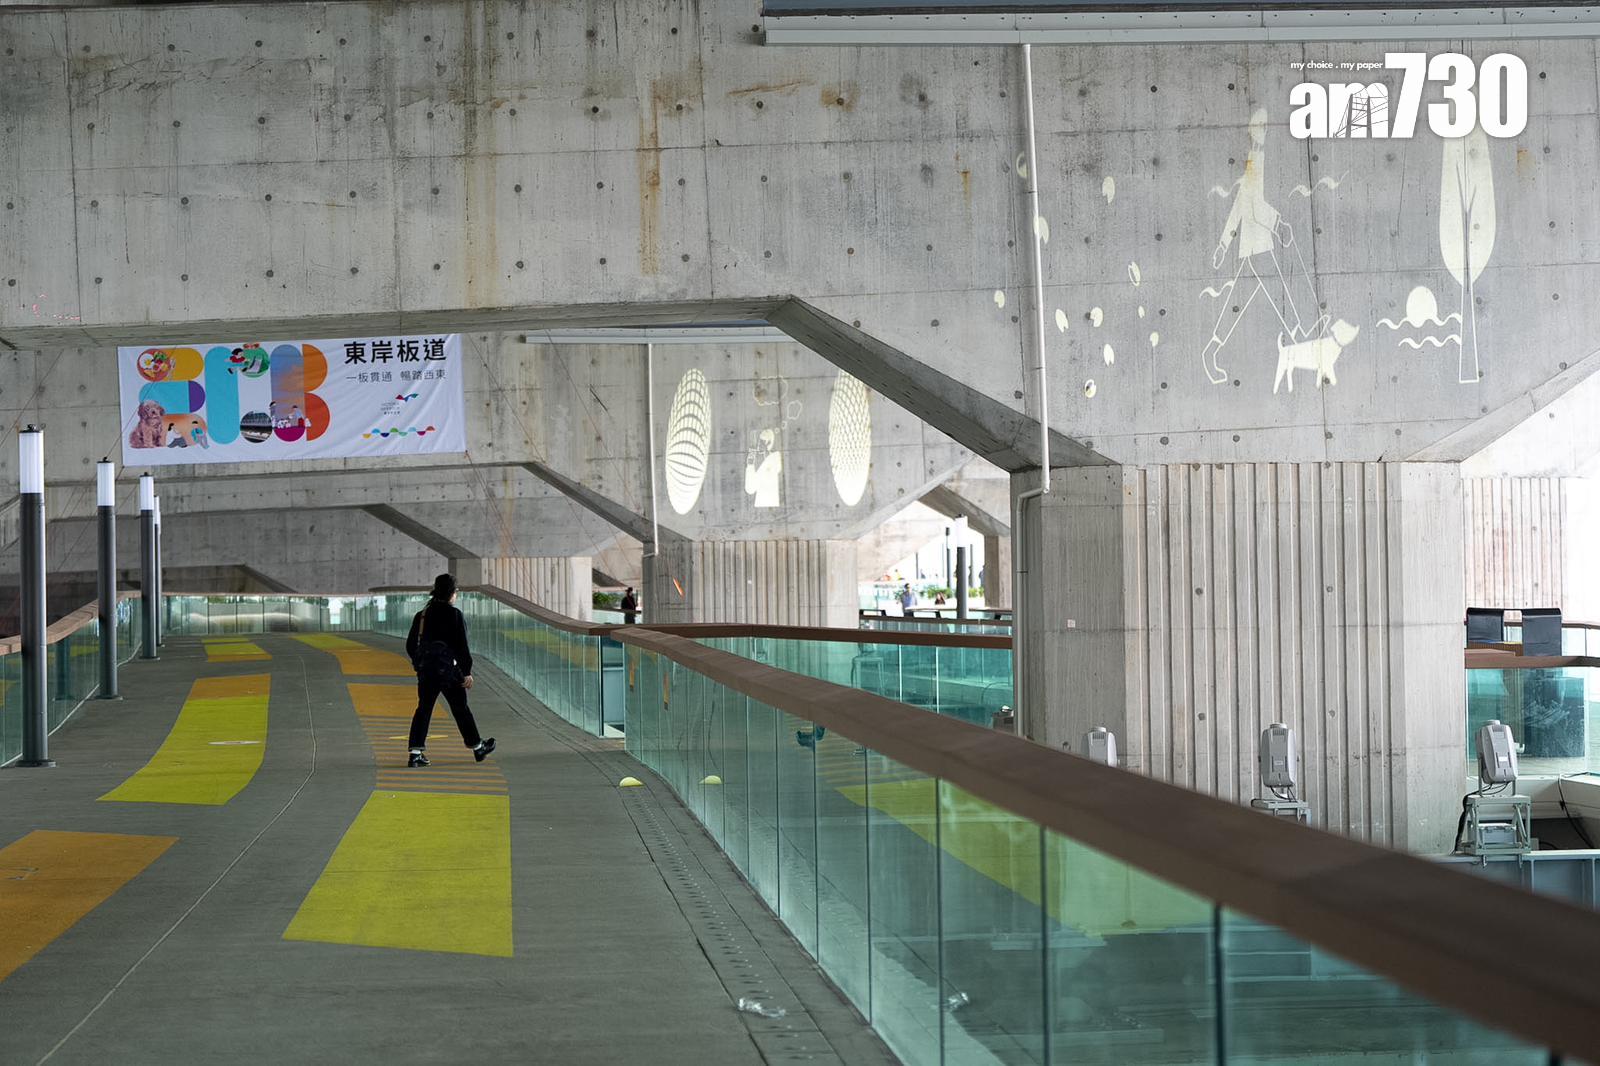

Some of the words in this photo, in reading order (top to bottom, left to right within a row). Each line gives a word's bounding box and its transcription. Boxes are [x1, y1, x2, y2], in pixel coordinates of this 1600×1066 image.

[344, 338, 447, 364] 東岸板道
[346, 371, 393, 383] 一板貫通
